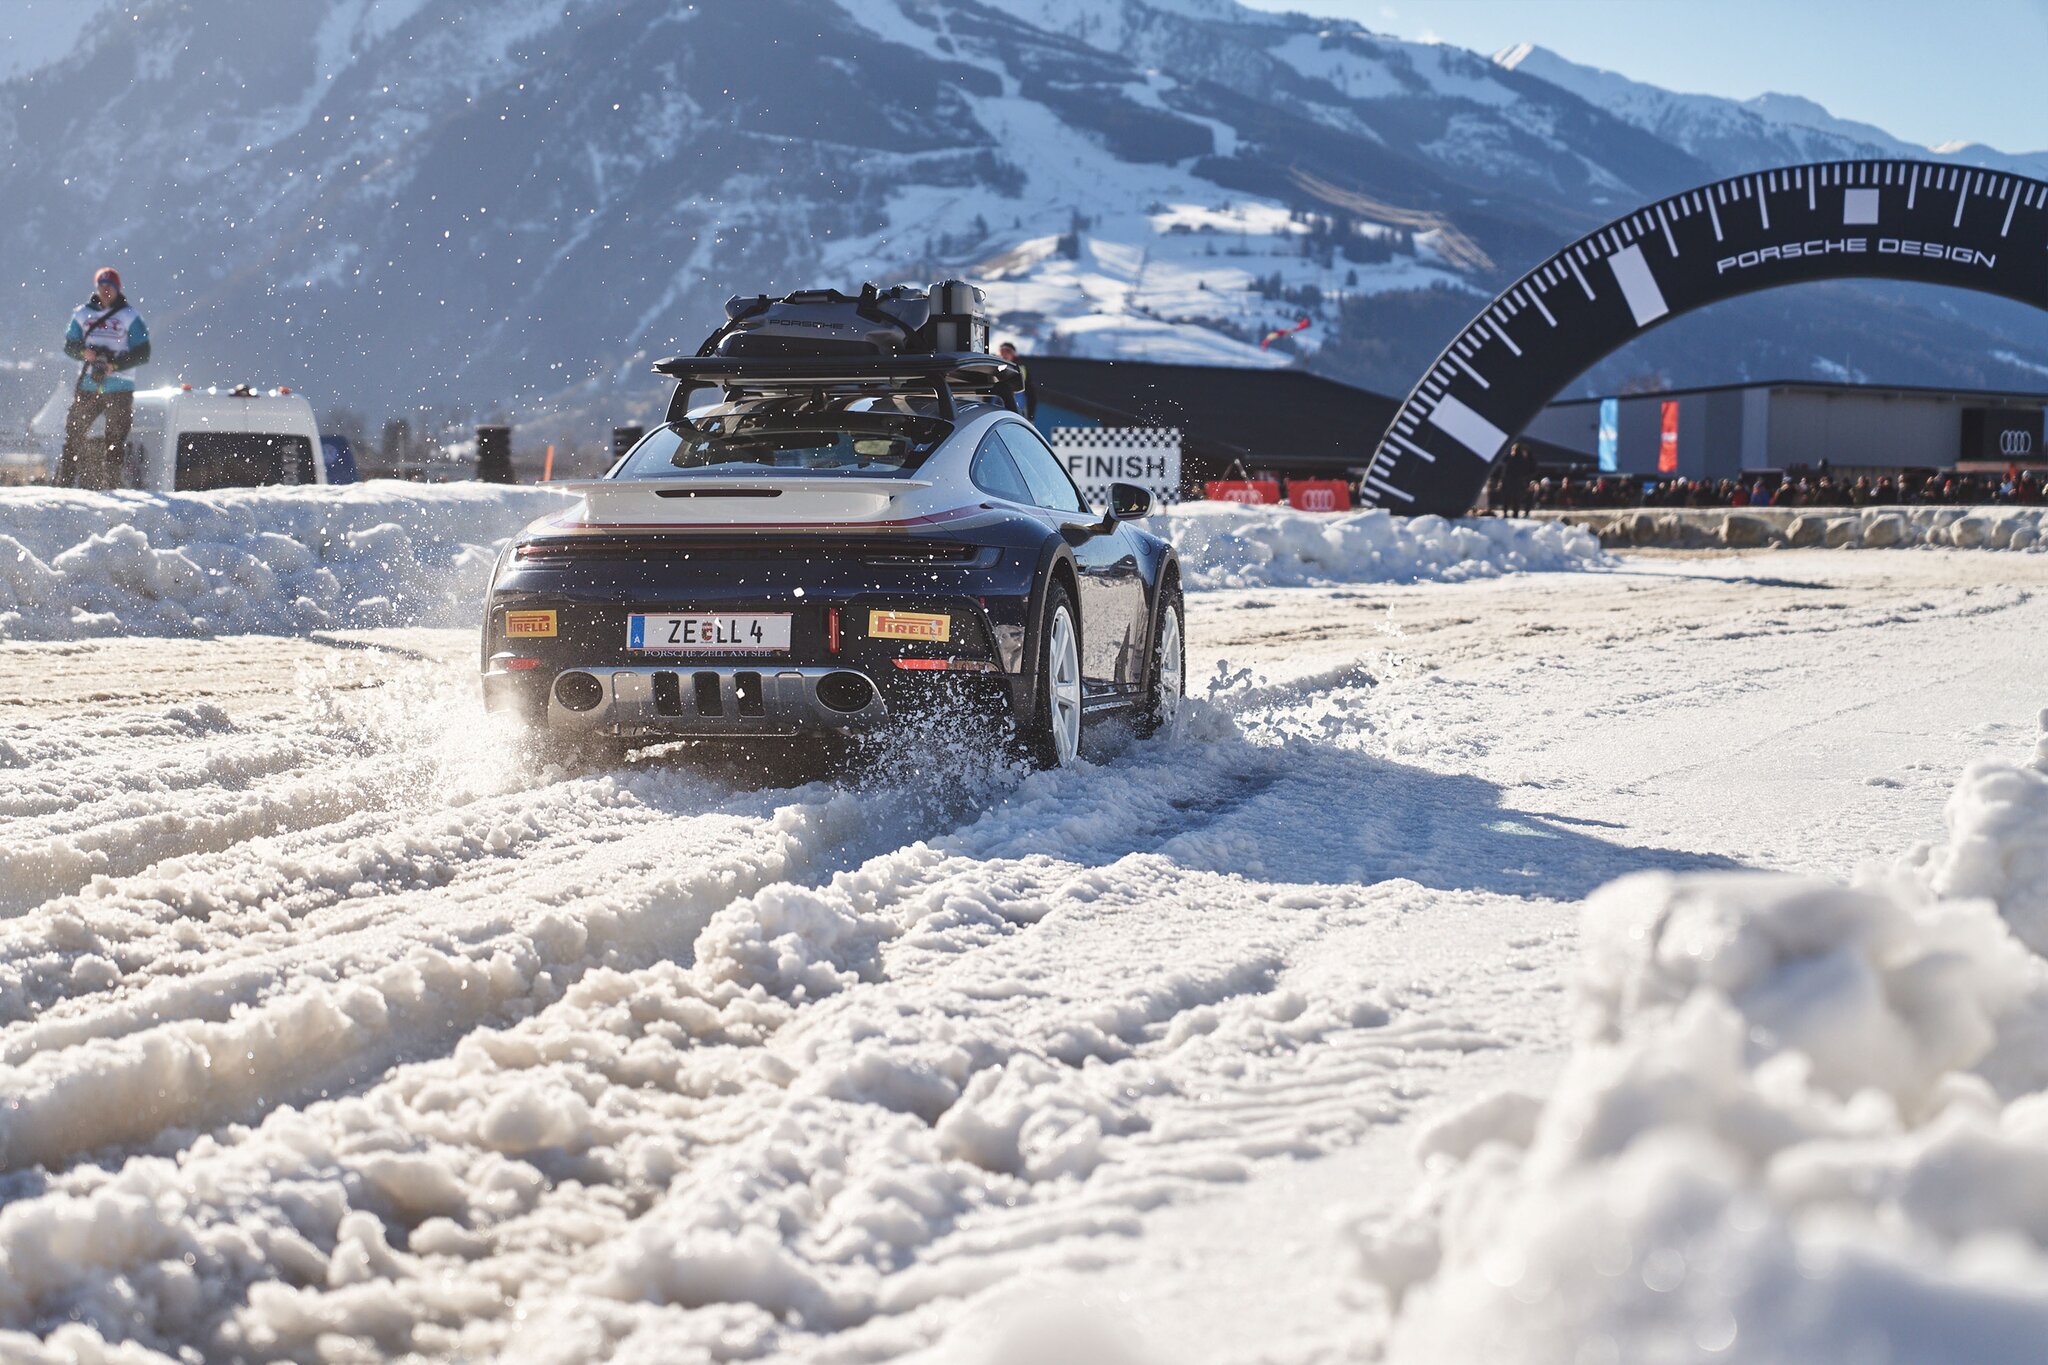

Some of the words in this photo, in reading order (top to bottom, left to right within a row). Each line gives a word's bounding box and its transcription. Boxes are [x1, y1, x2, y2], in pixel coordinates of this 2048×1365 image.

[1716, 238, 1867, 274] PORSCHE
[1878, 238, 1996, 268] DESIGN
[769, 319, 844, 330] PORSCHE
[1068, 456, 1165, 478] FINISH
[508, 615, 551, 632] PIRELLI
[633, 635, 641, 644] A
[750, 620, 763, 643] 4
[877, 616, 944, 636] PIRELLI
